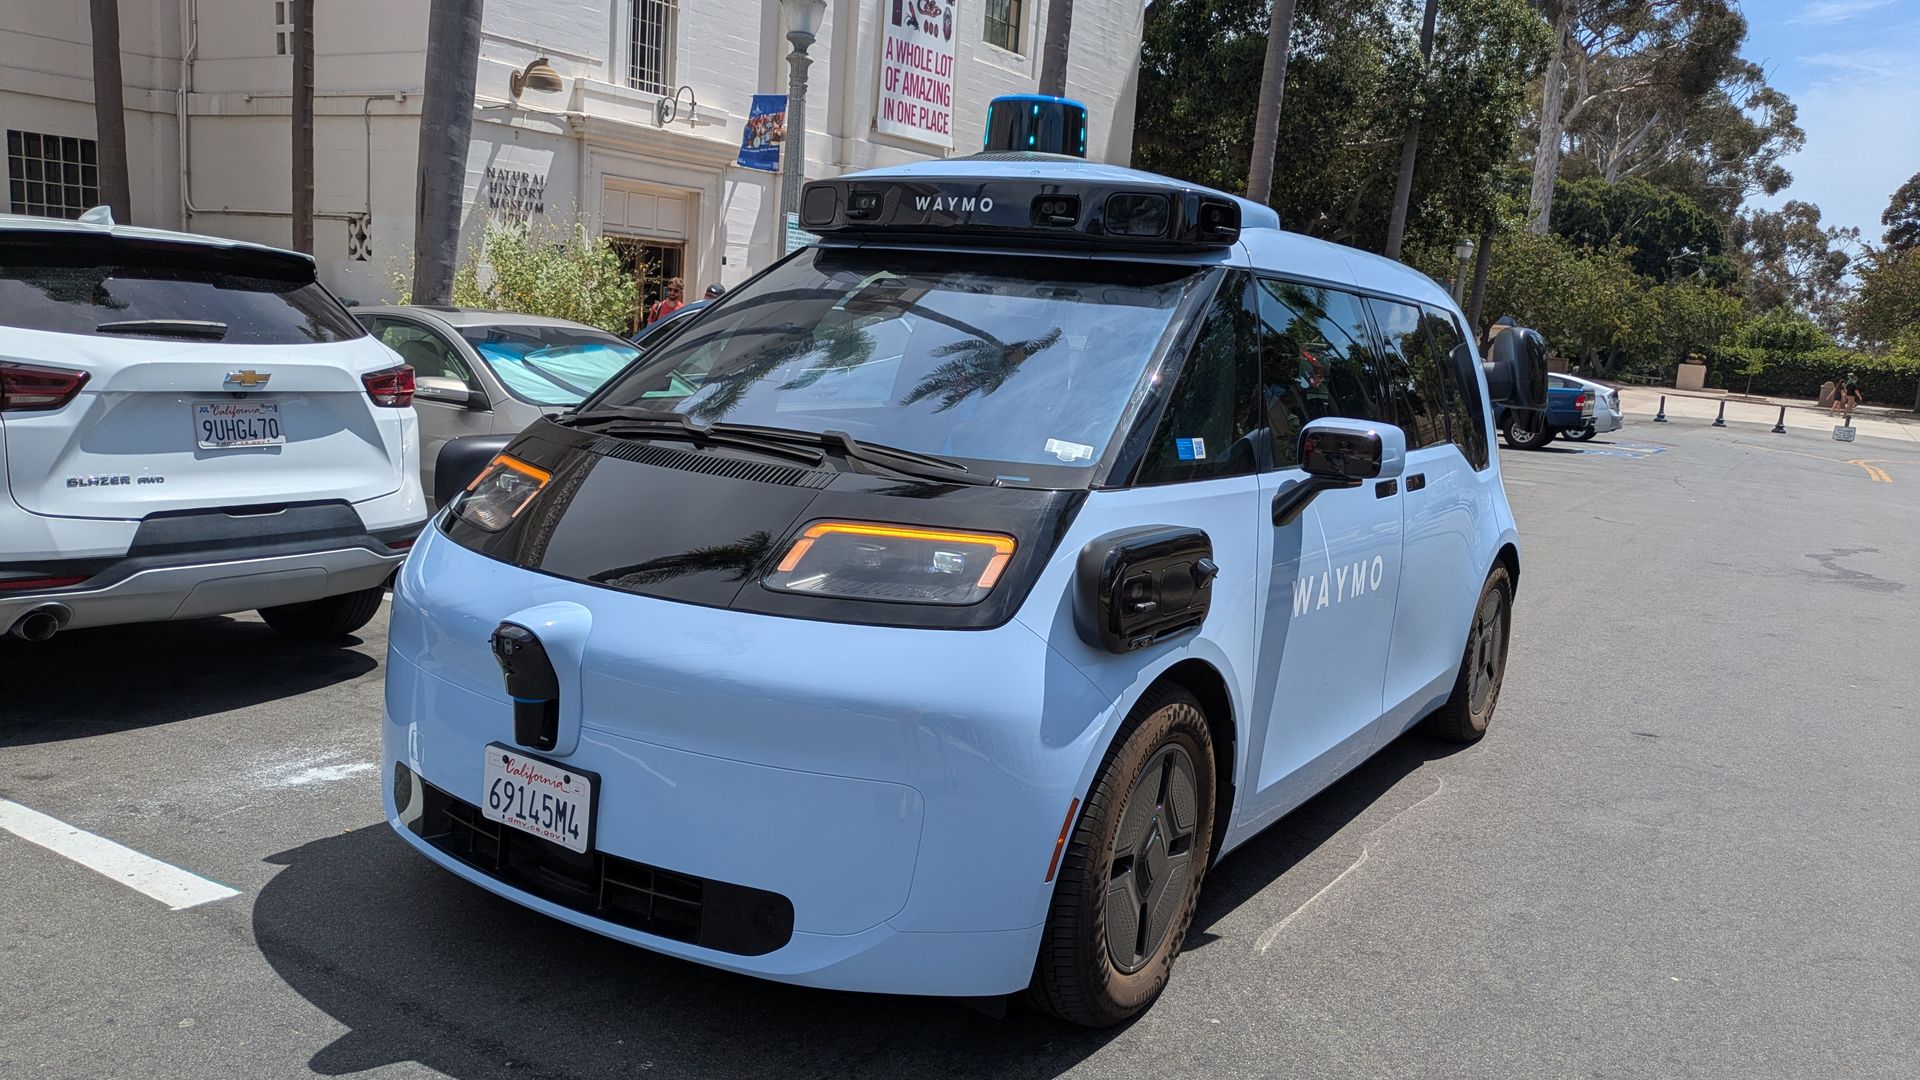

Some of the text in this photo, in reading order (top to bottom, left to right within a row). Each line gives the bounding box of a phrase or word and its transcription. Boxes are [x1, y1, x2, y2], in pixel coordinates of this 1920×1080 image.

[886, 36, 953, 78] A WHOLE LOT
[885, 66, 951, 108] OF AMAZING
[883, 97, 949, 134] IN ONE PLACE
[490, 182, 544, 199] HISTORY
[490, 197, 544, 213] MUSEUM
[915, 196, 993, 213] WAYMO
[212, 404, 265, 418] California
[202, 418, 279, 442] 9UHG470
[66, 476, 131, 488] BLAZER
[1292, 555, 1383, 618] WAYMO
[506, 758, 570, 794] California
[489, 777, 579, 840] 69145M4
[507, 817, 561, 841] dmv.ca.gov
